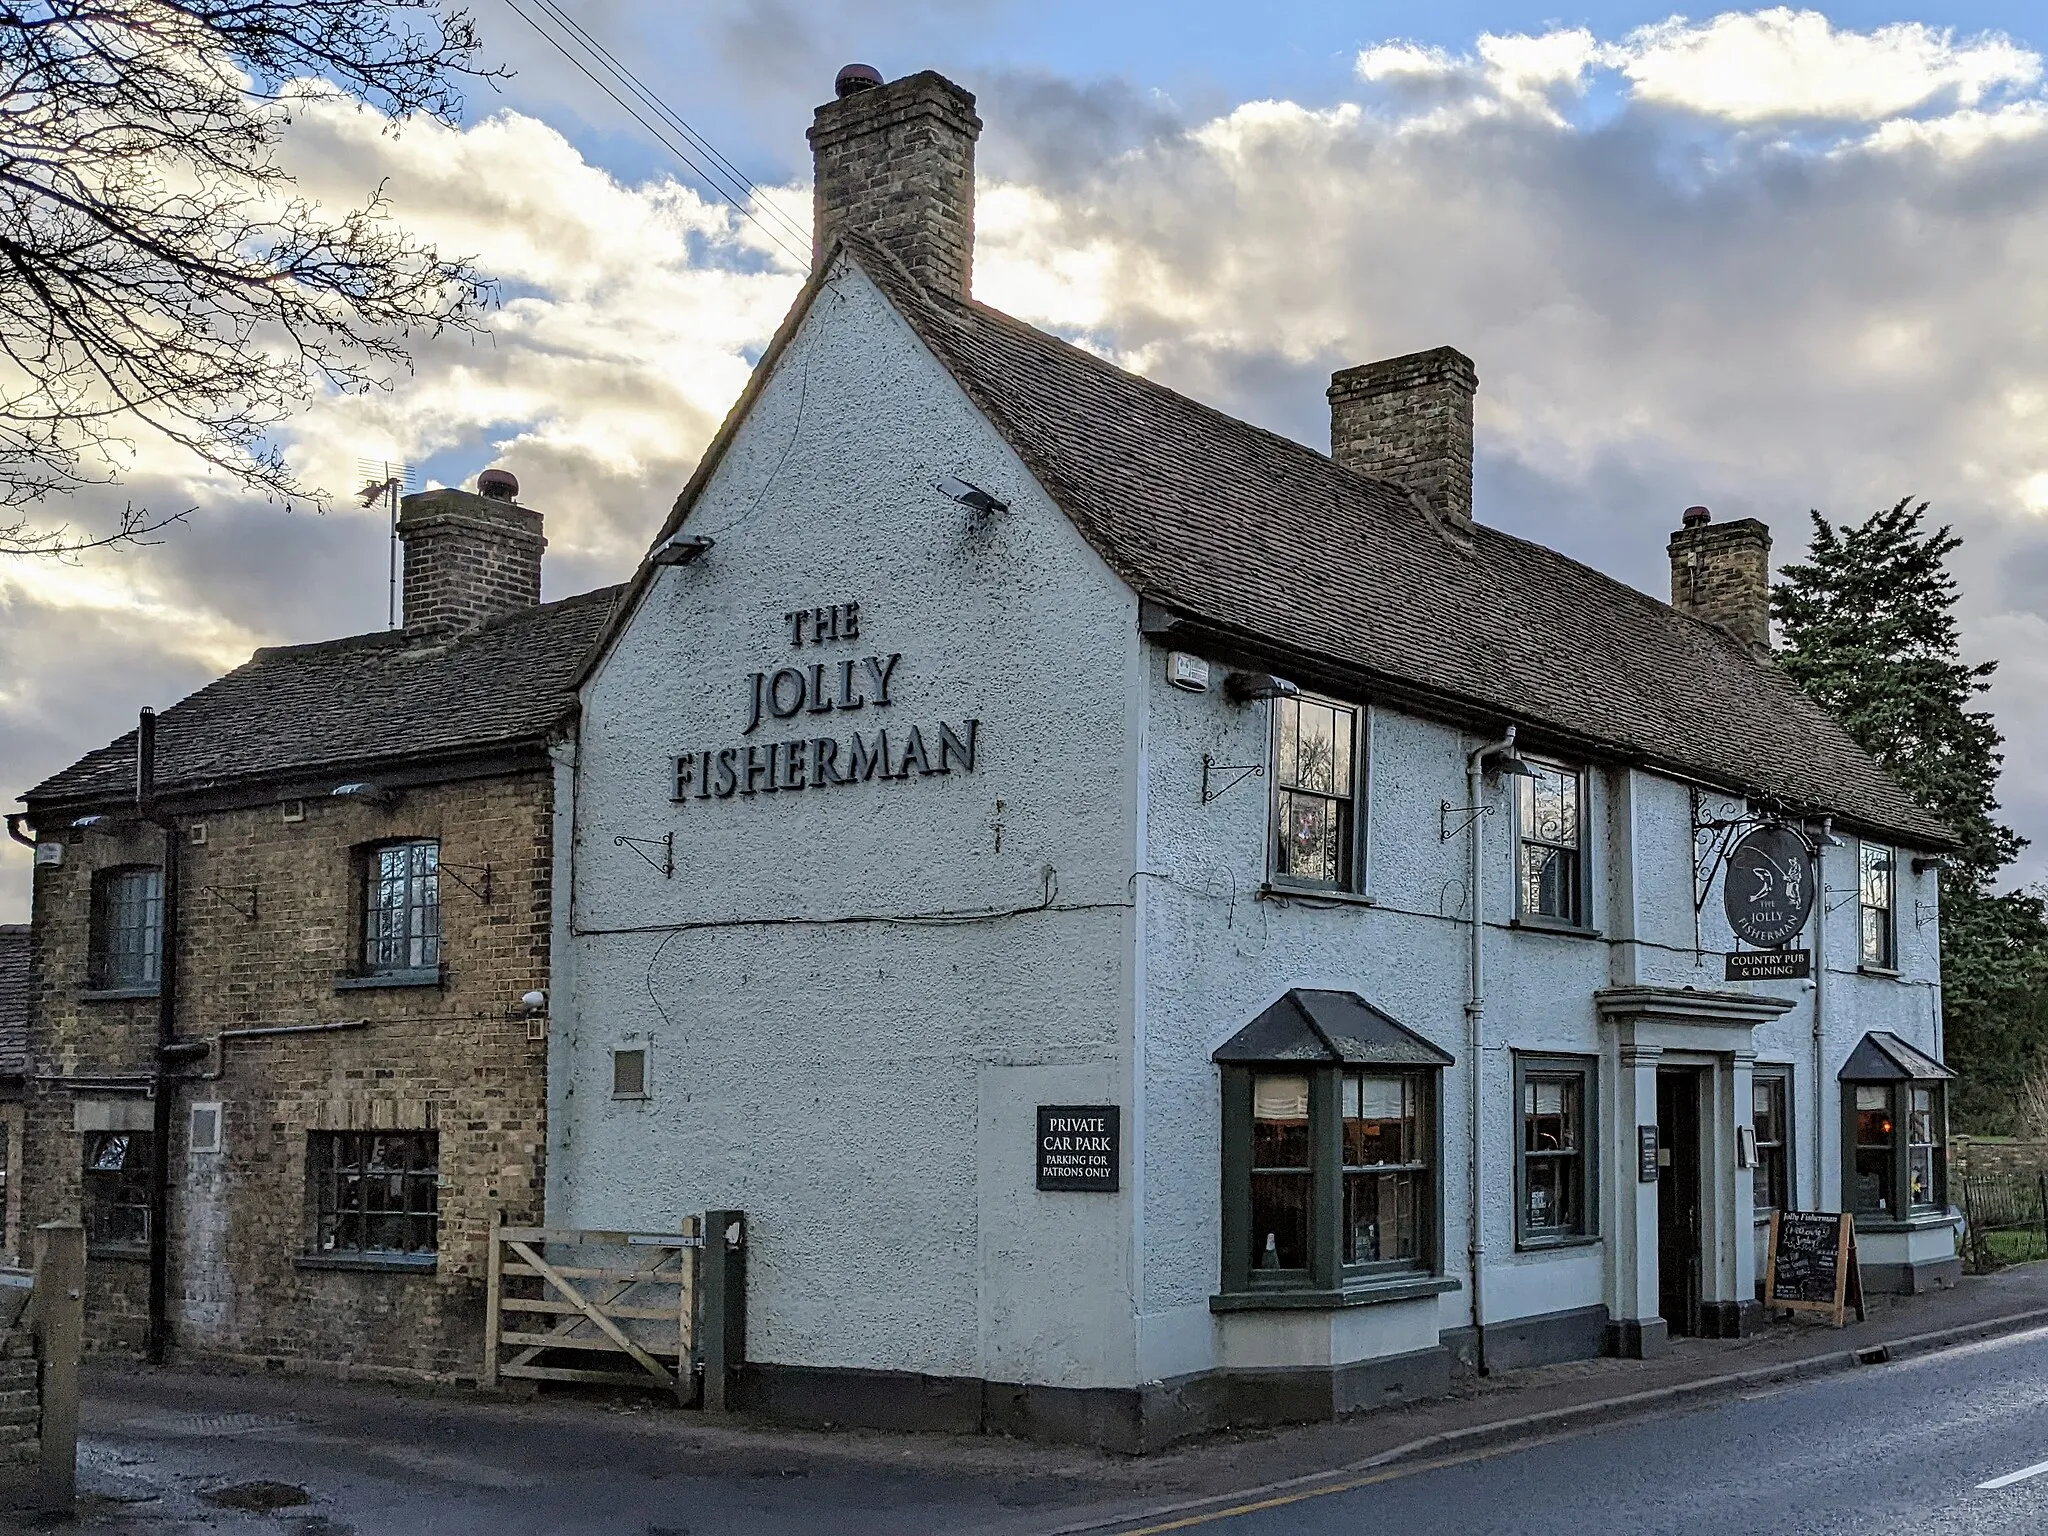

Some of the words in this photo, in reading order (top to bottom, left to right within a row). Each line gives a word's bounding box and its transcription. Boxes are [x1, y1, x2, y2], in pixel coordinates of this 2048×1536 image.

[784, 601, 860, 646] THE
[742, 653, 902, 735] JOLLY
[669, 719, 980, 802] FISHERMAN
[1760, 900, 1775, 908] THE
[1751, 912, 1783, 923] JOLLY
[1738, 914, 1798, 941] FISHERMAN
[1731, 955, 1782, 966] COUNTRY
[1784, 953, 1805, 964] PUB
[1741, 967, 1750, 976] &
[1752, 966, 1793, 976] DINING
[1049, 1118, 1104, 1132] PRIVATE
[1043, 1136, 1072, 1150] CAR
[1075, 1137, 1111, 1151] PARK
[1046, 1155, 1086, 1165] PARKING
[1089, 1155, 1107, 1165] FOR
[1043, 1167, 1083, 1176] PATRONS
[1085, 1167, 1111, 1177] ONLY
[1800, 1213, 1838, 1223] Fisherman
